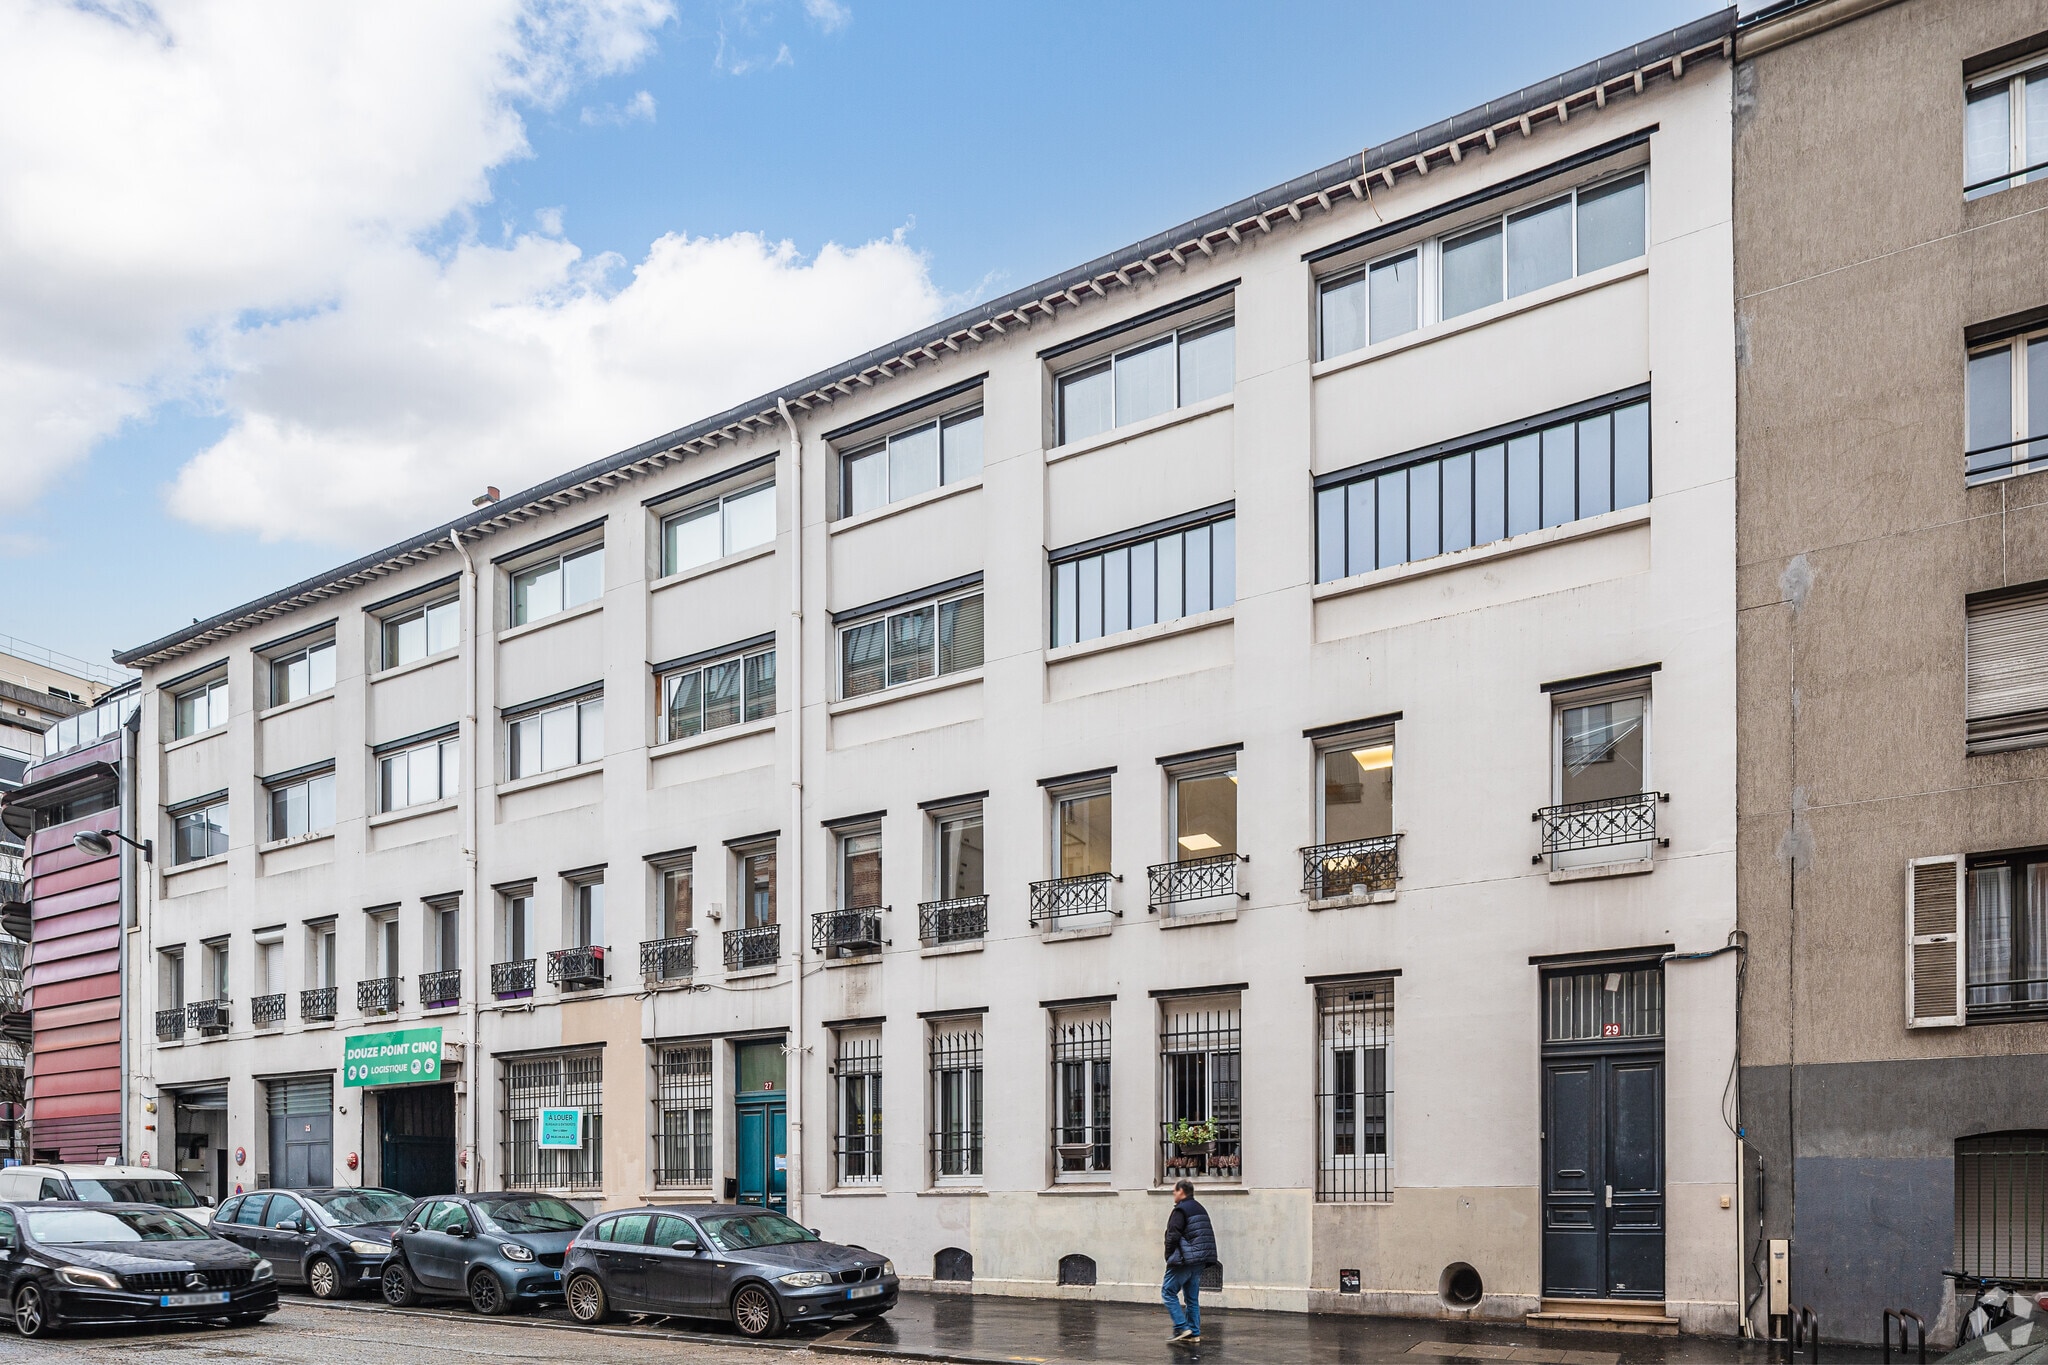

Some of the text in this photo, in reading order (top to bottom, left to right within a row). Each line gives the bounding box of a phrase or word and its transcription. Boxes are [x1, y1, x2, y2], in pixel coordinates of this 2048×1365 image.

[1605, 1025, 1619, 1035] 29
[347, 1040, 438, 1060] DOUZE POINT CINQ
[371, 1064, 408, 1075] LOGISTIQUE
[764, 1082, 773, 1090] 27
